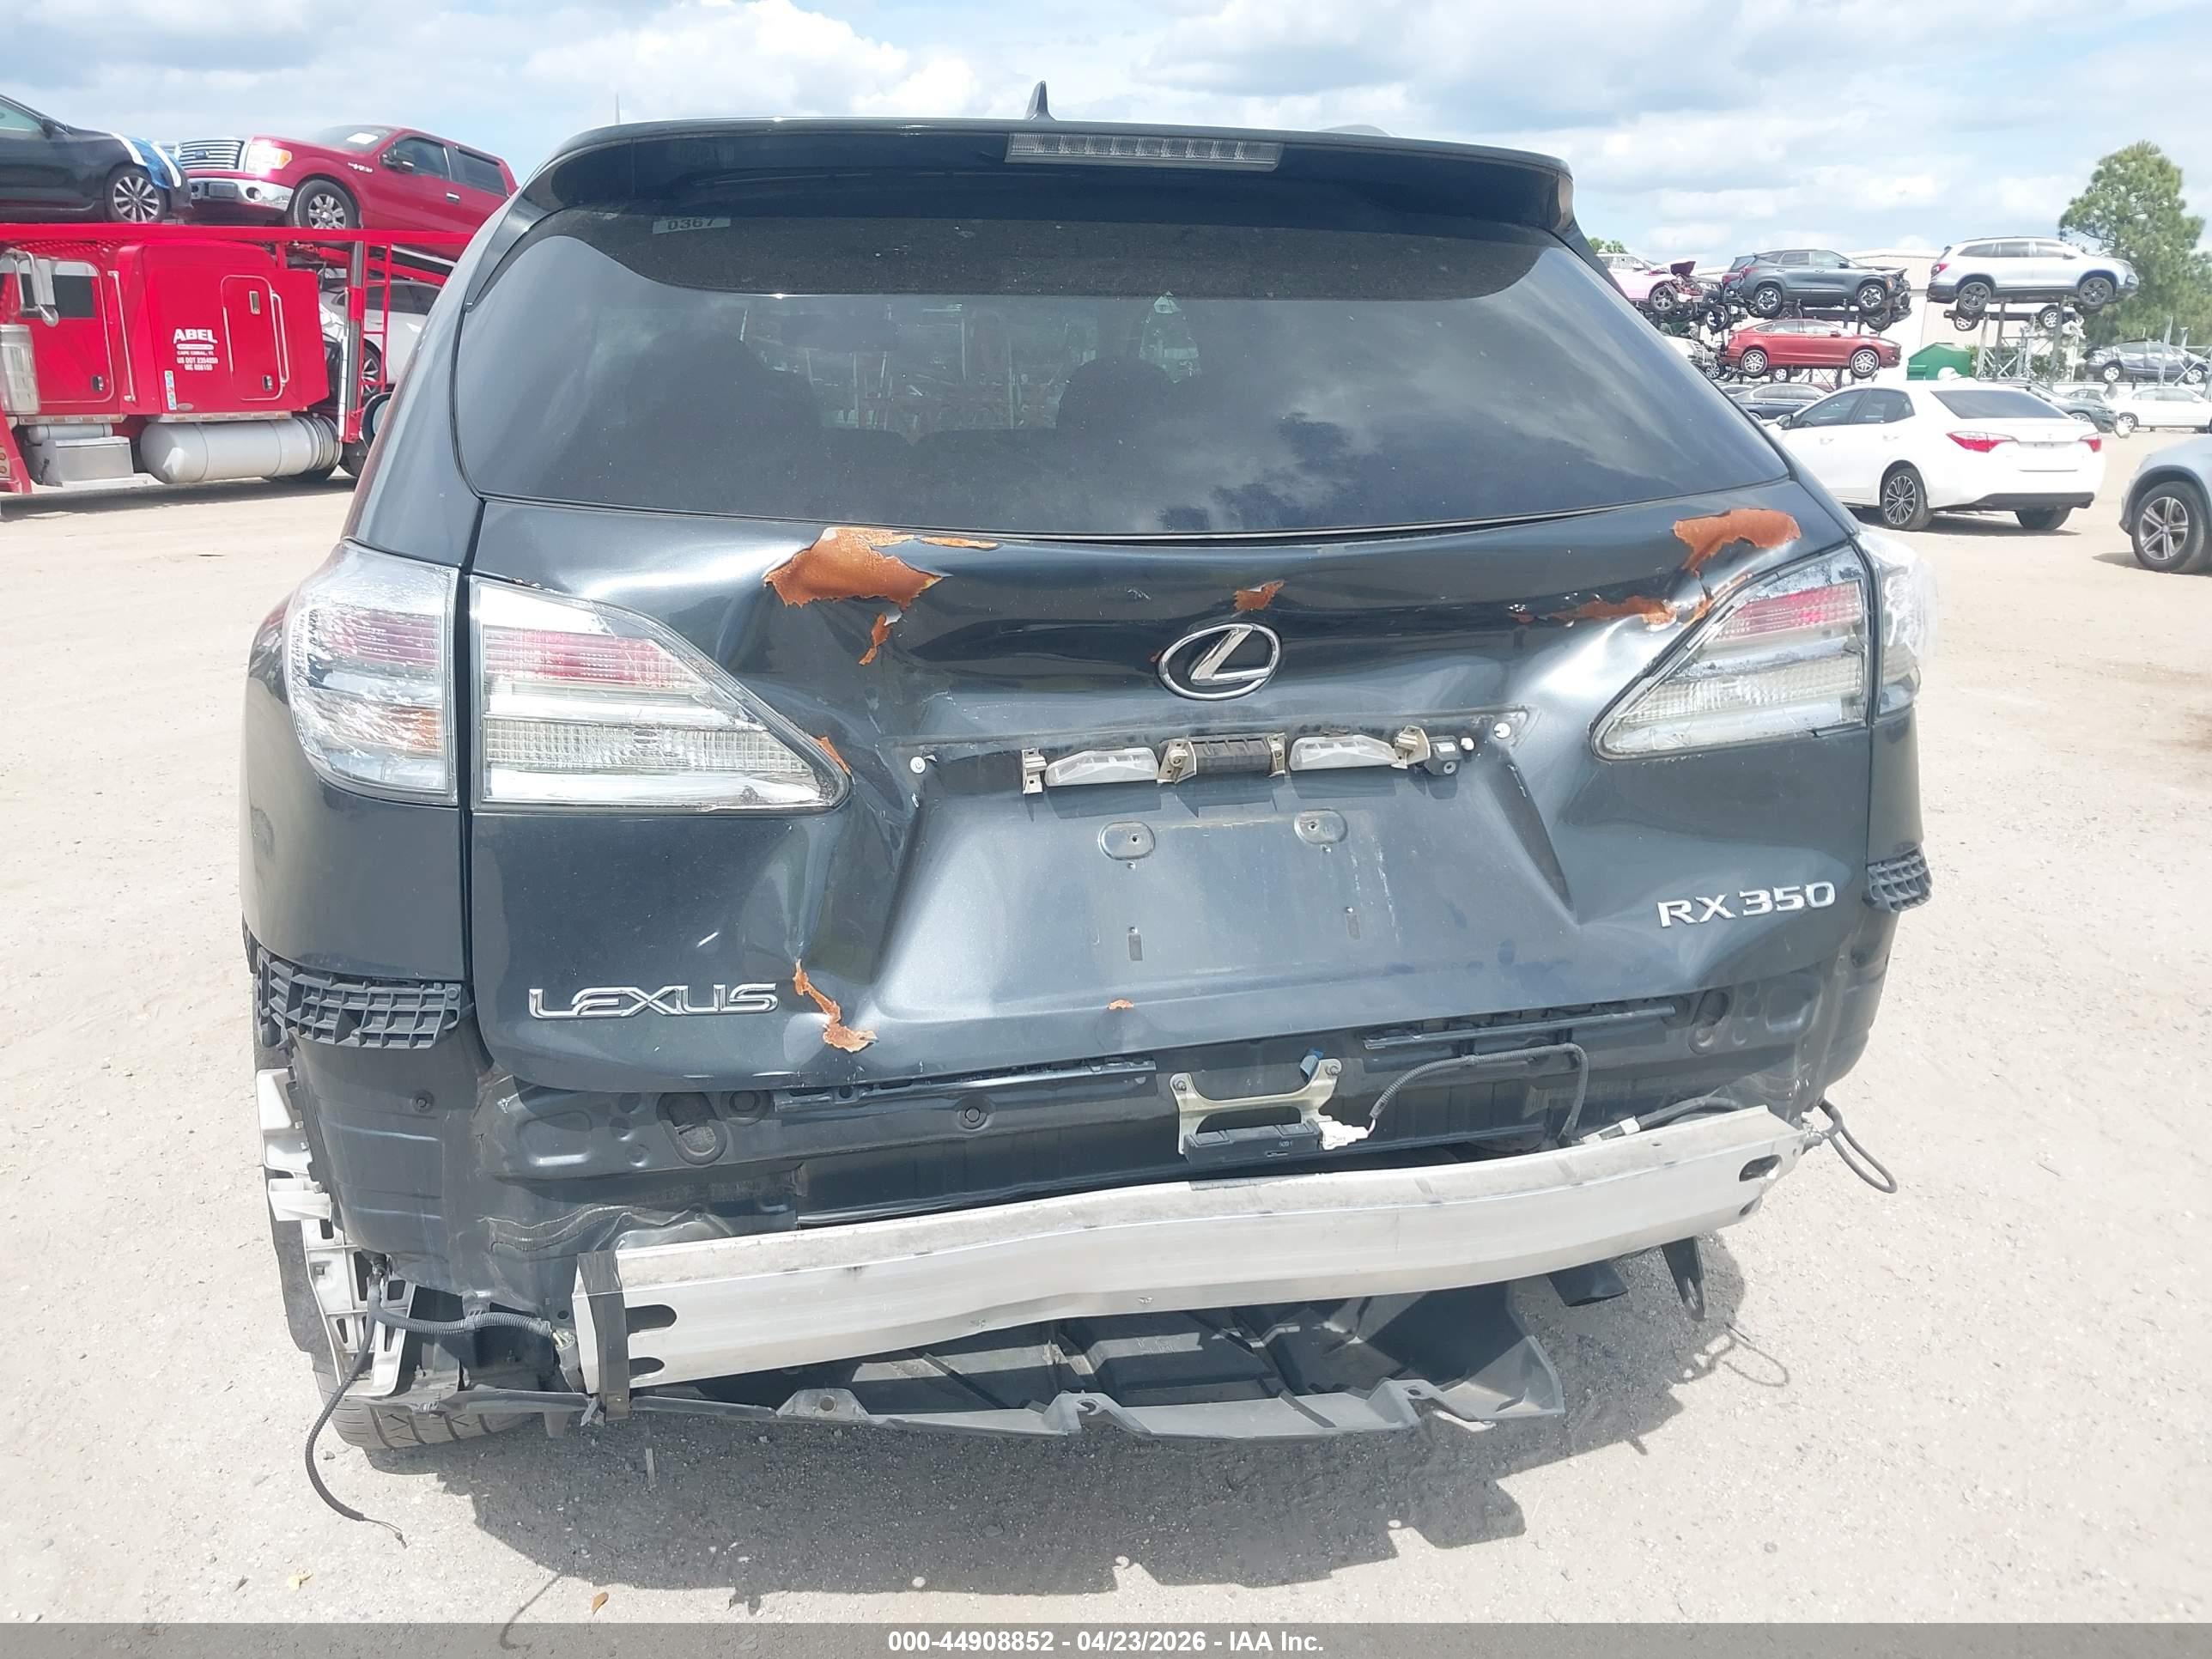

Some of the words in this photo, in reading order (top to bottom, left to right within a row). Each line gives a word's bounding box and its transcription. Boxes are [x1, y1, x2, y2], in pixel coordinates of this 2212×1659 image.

[173, 328, 218, 343] ABEL
[1657, 893, 1736, 927] RX
[1739, 881, 1836, 916] 350
[528, 982, 778, 1019] LEXUS
